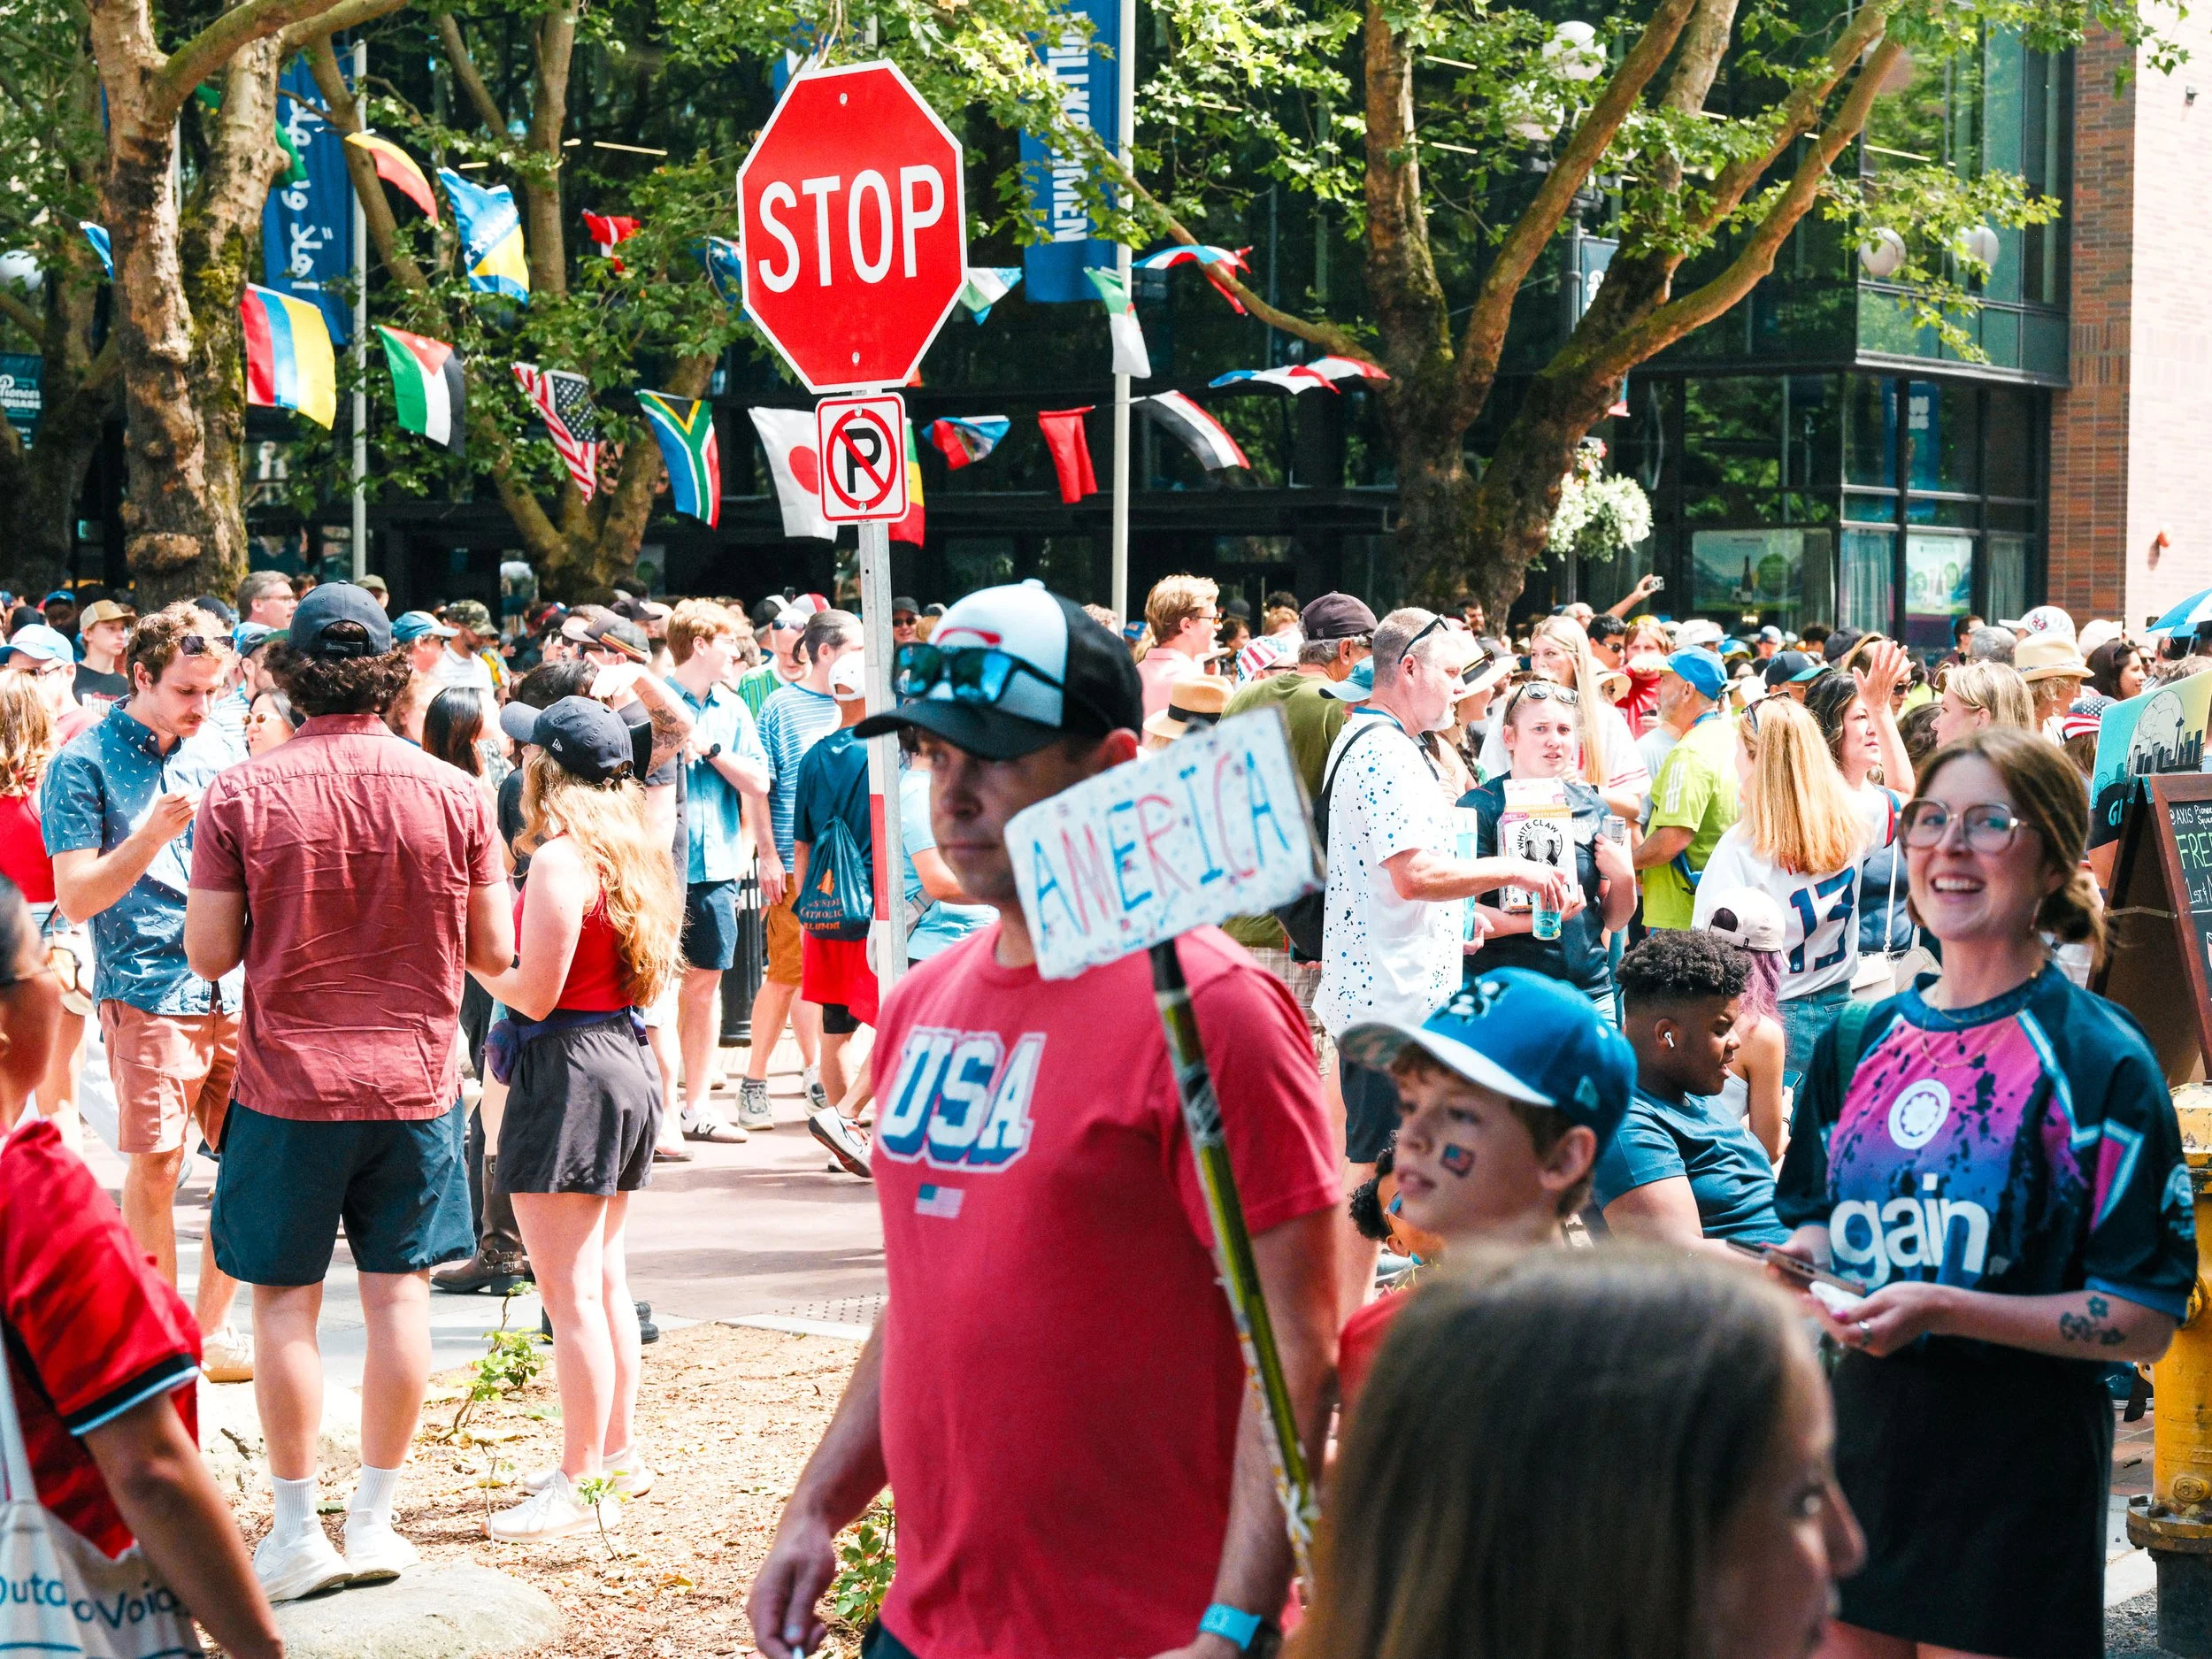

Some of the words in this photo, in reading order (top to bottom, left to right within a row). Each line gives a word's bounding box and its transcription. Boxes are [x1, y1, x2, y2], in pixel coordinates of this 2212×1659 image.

[758, 164, 945, 294] STOP
[845, 427, 882, 494] P
[1033, 751, 1290, 954] AMERICA
[1517, 822, 1532, 850] WHITE
[1532, 818, 1559, 833] CLAW
[2175, 832, 2212, 870] FRE
[1789, 865, 1855, 974] 13
[879, 1026, 1046, 1171] USA
